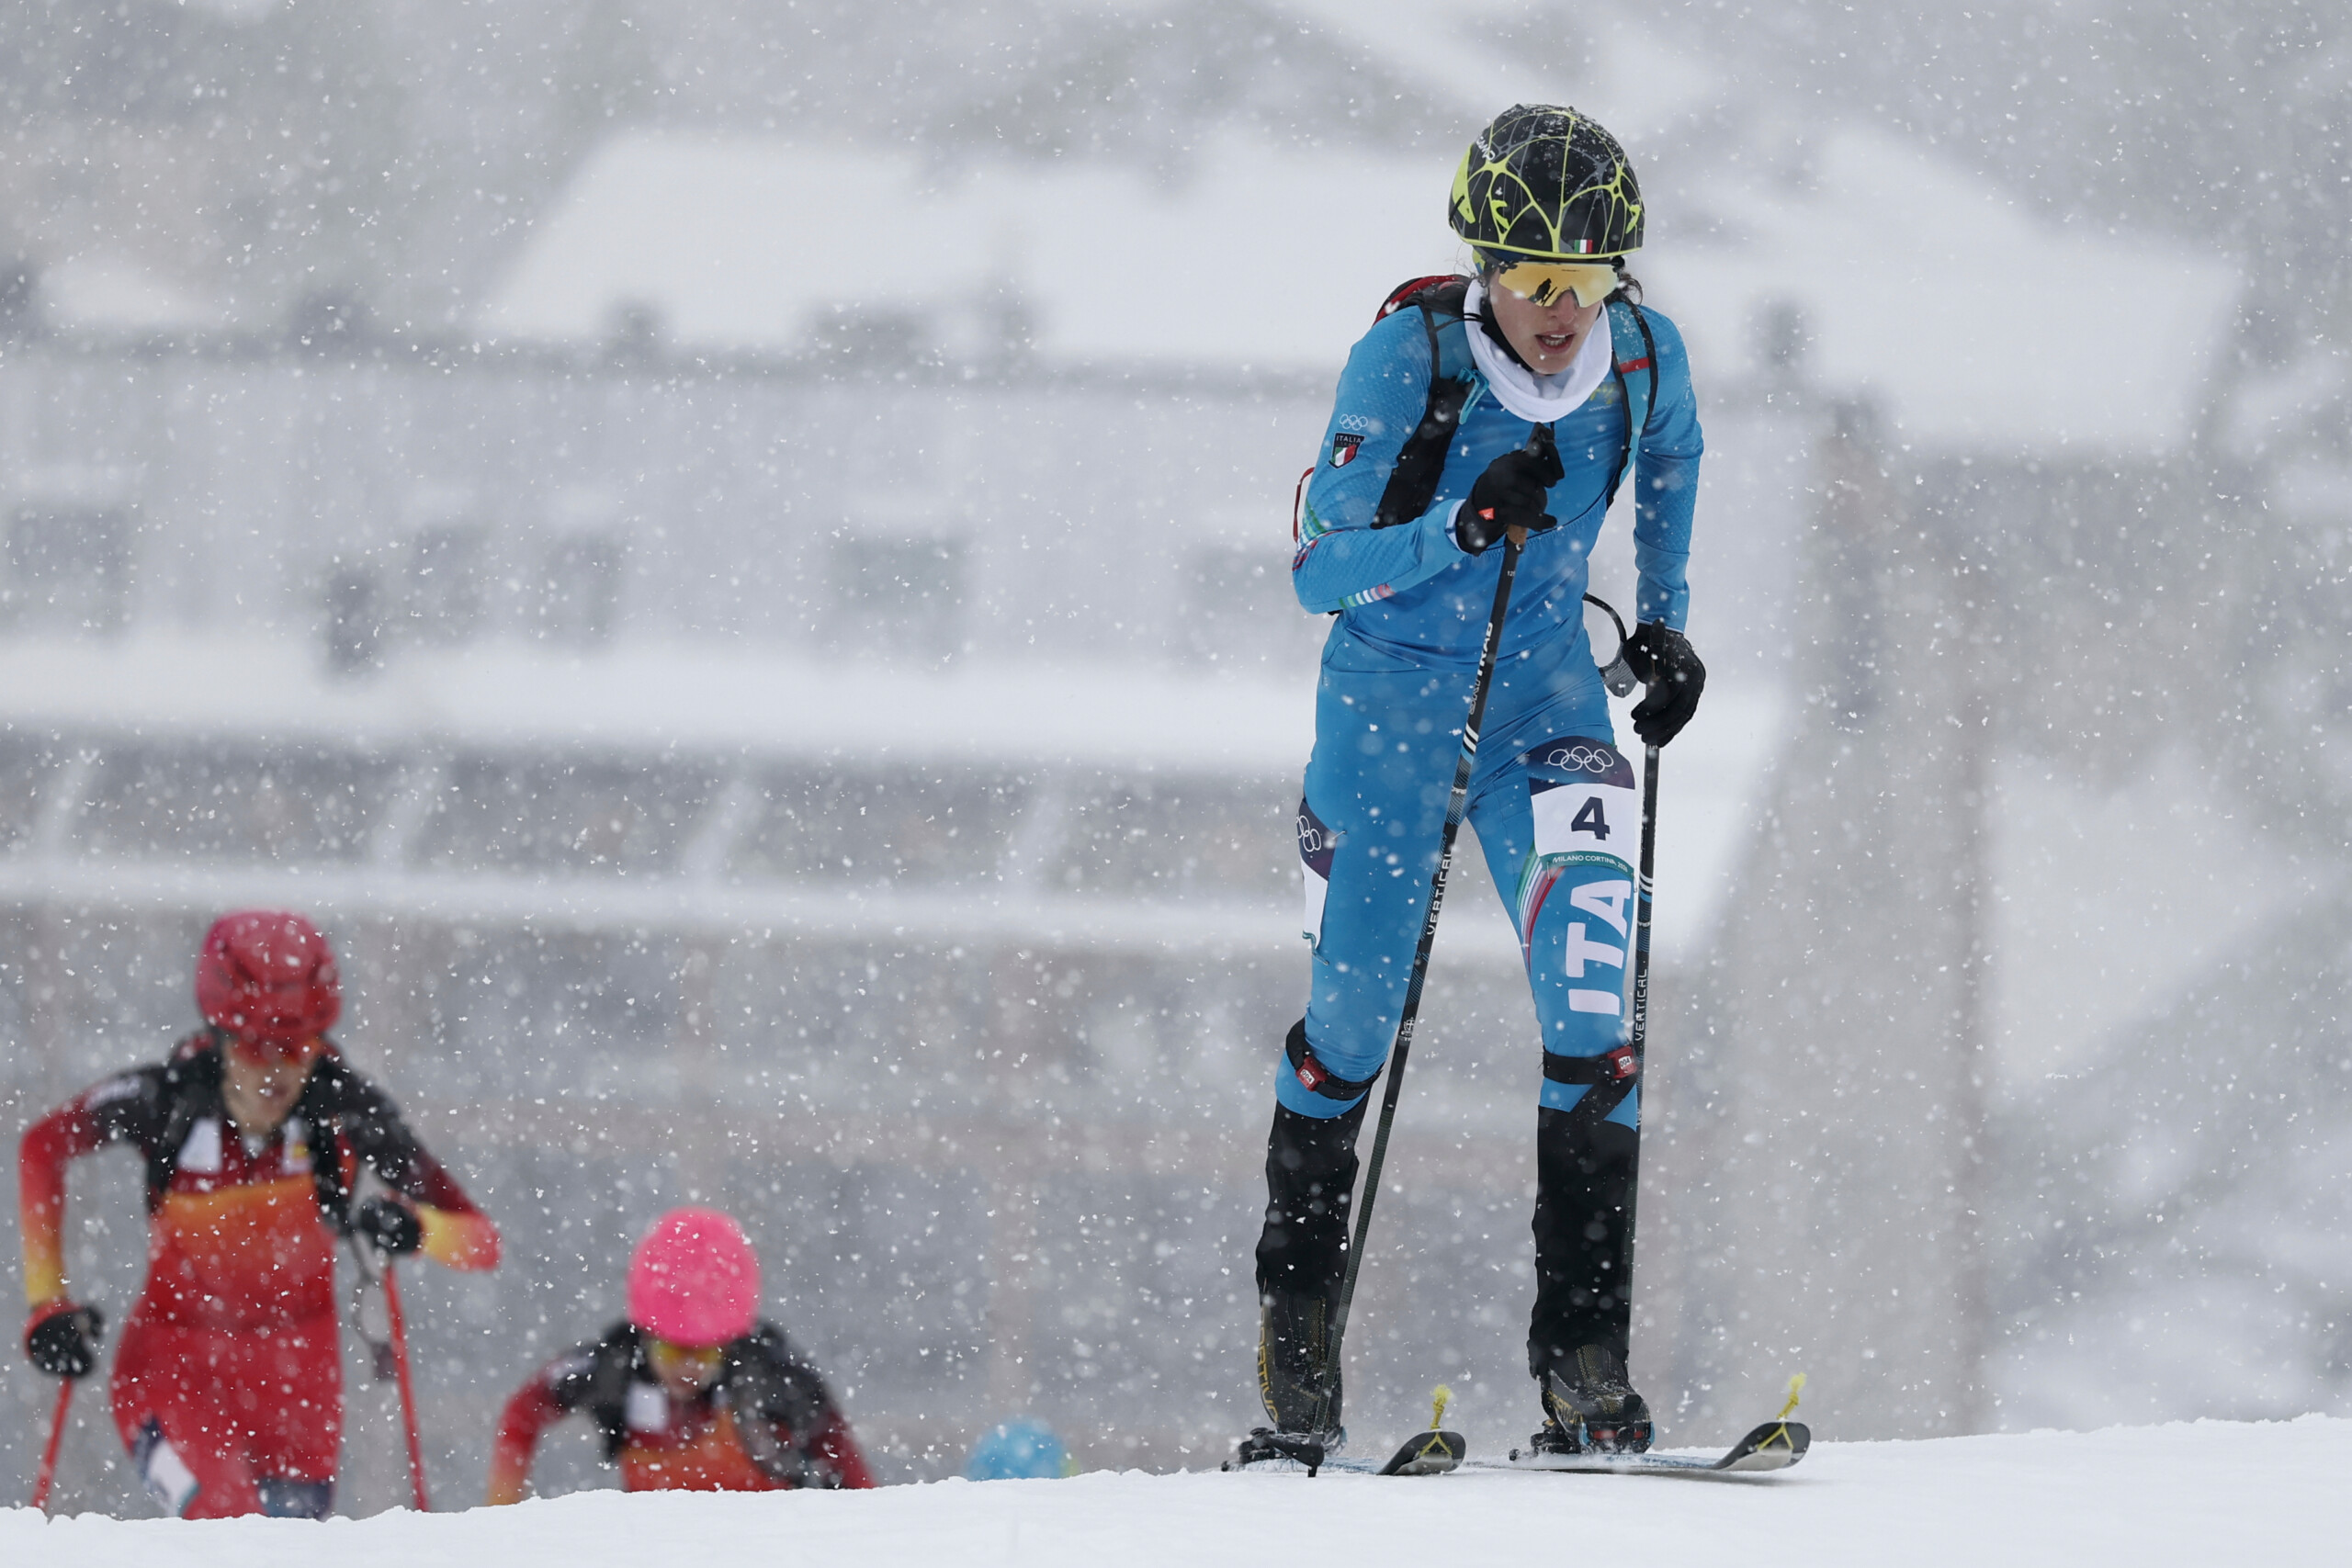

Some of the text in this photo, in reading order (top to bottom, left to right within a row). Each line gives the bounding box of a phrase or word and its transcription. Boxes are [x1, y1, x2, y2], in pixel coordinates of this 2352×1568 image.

[1336, 434, 1362, 444] ITALIA
[1570, 795, 1611, 841] 4
[1553, 854, 1584, 864] MILANO
[1585, 855, 1617, 866] CORTINA
[1427, 852, 1453, 935] VERTICAL
[1566, 879, 1632, 1017] ITA
[1634, 968, 1647, 1041] VERTICAL
